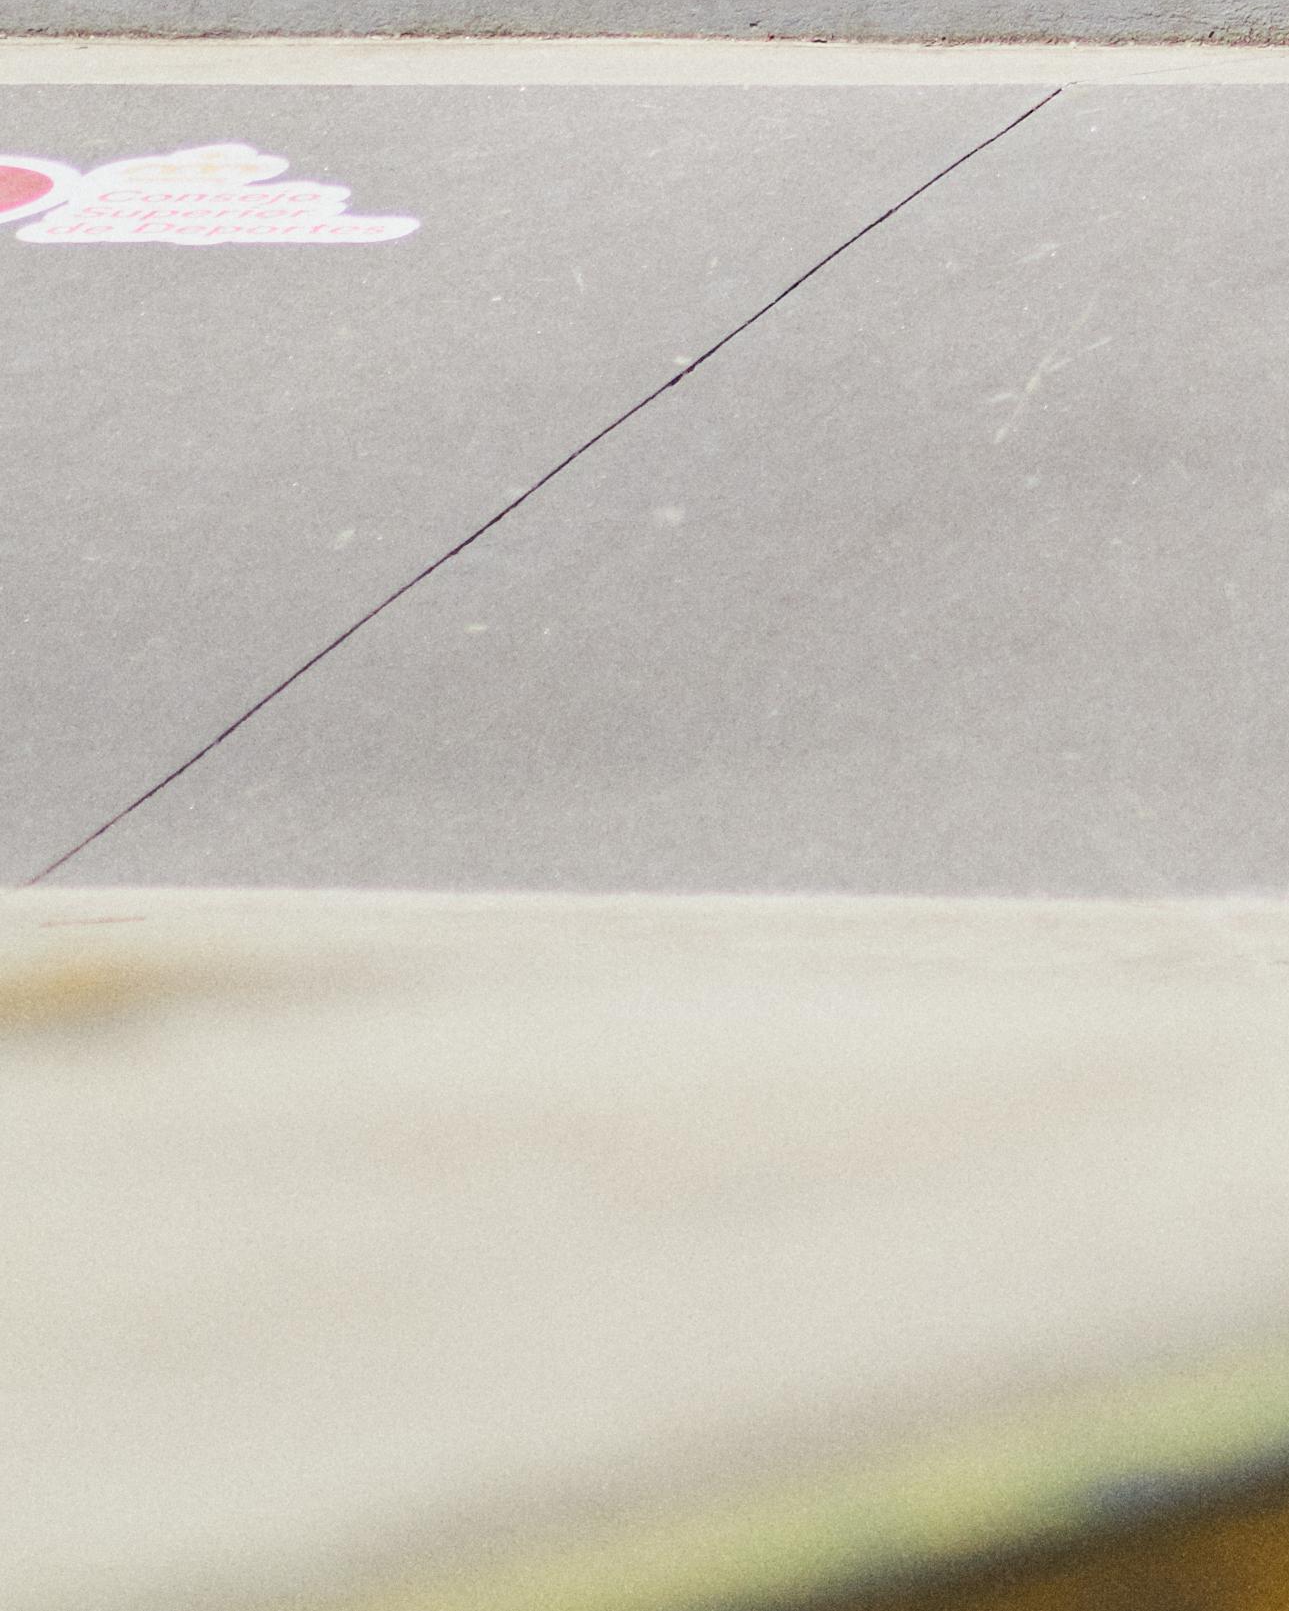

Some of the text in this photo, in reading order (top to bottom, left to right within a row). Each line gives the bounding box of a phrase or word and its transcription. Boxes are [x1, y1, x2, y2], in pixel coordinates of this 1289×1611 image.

[97, 189, 322, 205] Consejo
[74, 206, 307, 222] Superior
[46, 221, 387, 238] de Deportes
